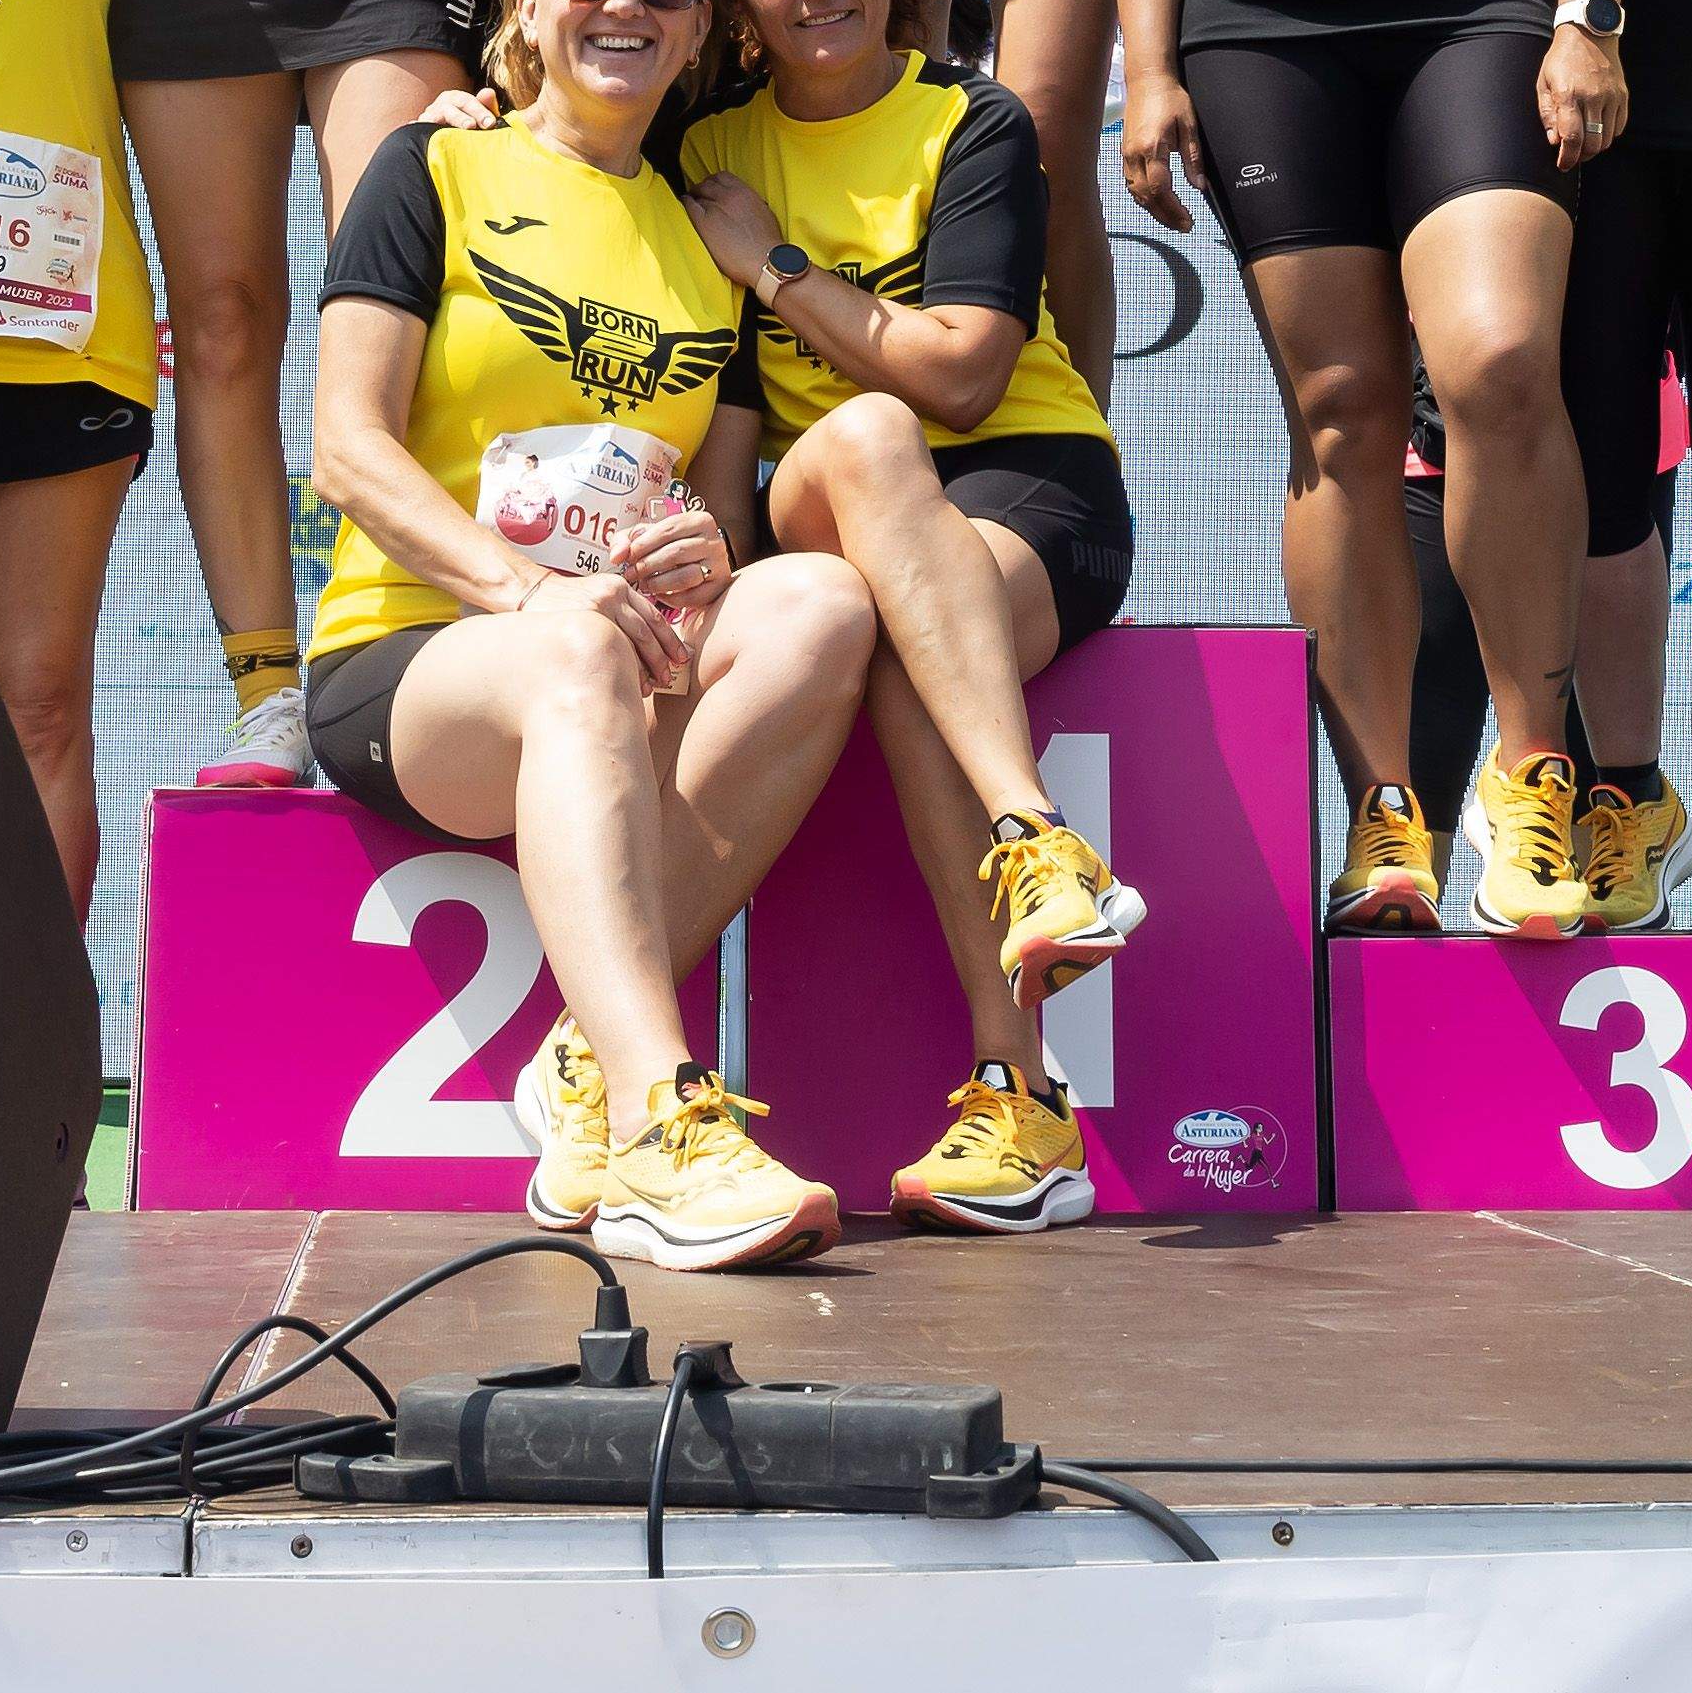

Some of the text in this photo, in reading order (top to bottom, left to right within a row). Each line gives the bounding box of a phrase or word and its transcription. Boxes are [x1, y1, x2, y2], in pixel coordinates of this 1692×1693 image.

[52, 173, 89, 191] SUMA
[0, 284, 43, 302] MUJER
[46, 293, 73, 308] 2023
[9, 316, 80, 333] Santander
[584, 303, 655, 345] BORN
[578, 351, 654, 394] RUN
[576, 550, 600, 573] 546
[339, 853, 545, 1159] 2
[1181, 1123, 1244, 1138] ASTURIANA
[1168, 1143, 1230, 1164] Carrera
[1183, 1162, 1253, 1193] de la Mujer
